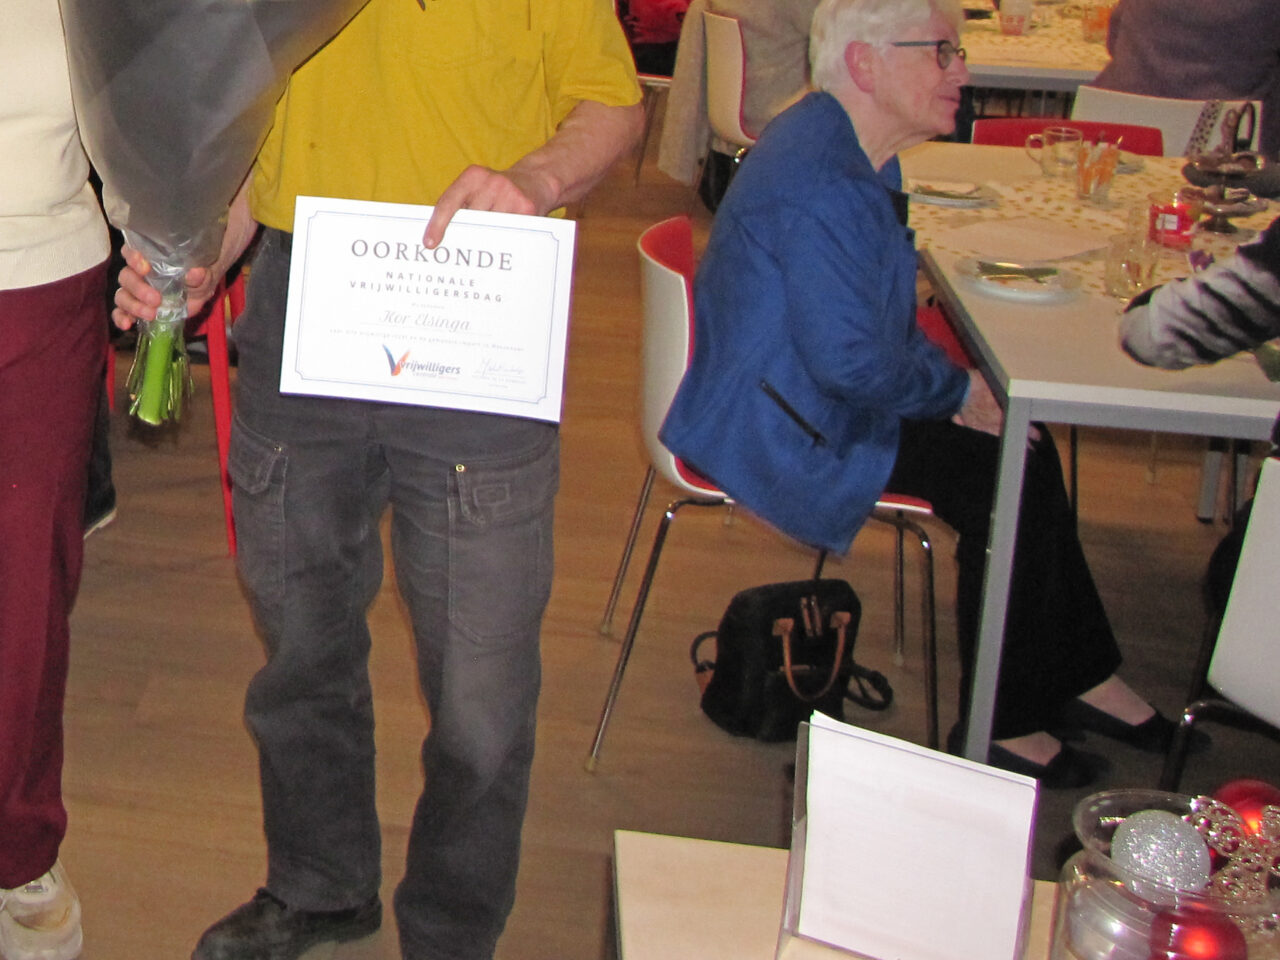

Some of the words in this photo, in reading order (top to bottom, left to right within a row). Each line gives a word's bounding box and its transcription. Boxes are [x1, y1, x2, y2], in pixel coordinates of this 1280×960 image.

[351, 239, 513, 271] OORKONDE
[386, 271, 476, 288] NATIONALE
[350, 280, 503, 303] VRIJWILLIGERSDAG
[400, 359, 461, 375] vrijwilligers
